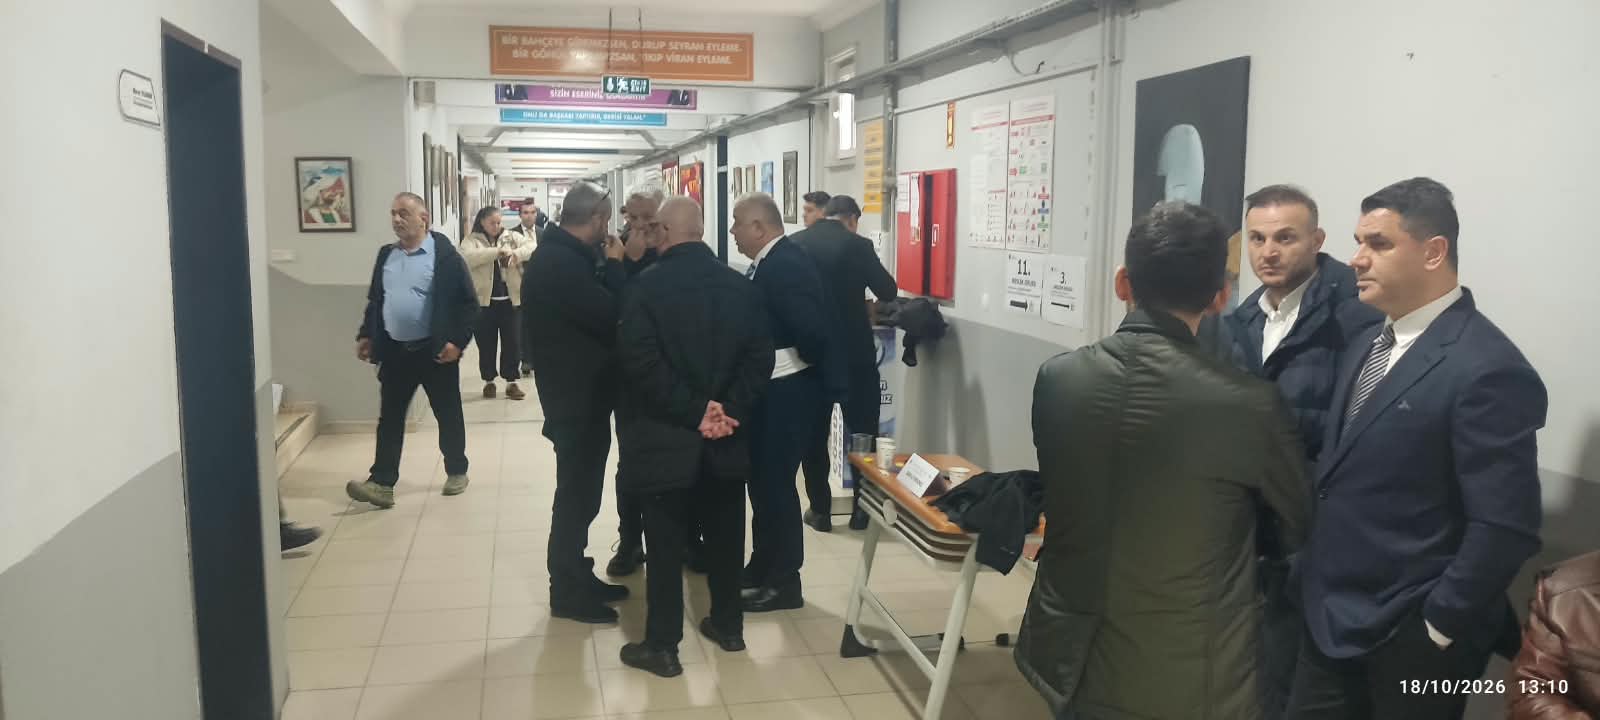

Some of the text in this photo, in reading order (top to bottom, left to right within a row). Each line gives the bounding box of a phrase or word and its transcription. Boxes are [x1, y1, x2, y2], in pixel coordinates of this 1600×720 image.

[501, 33, 519, 45] BİR
[512, 47, 529, 58] BİR
[1017, 259, 1031, 276] 11.
